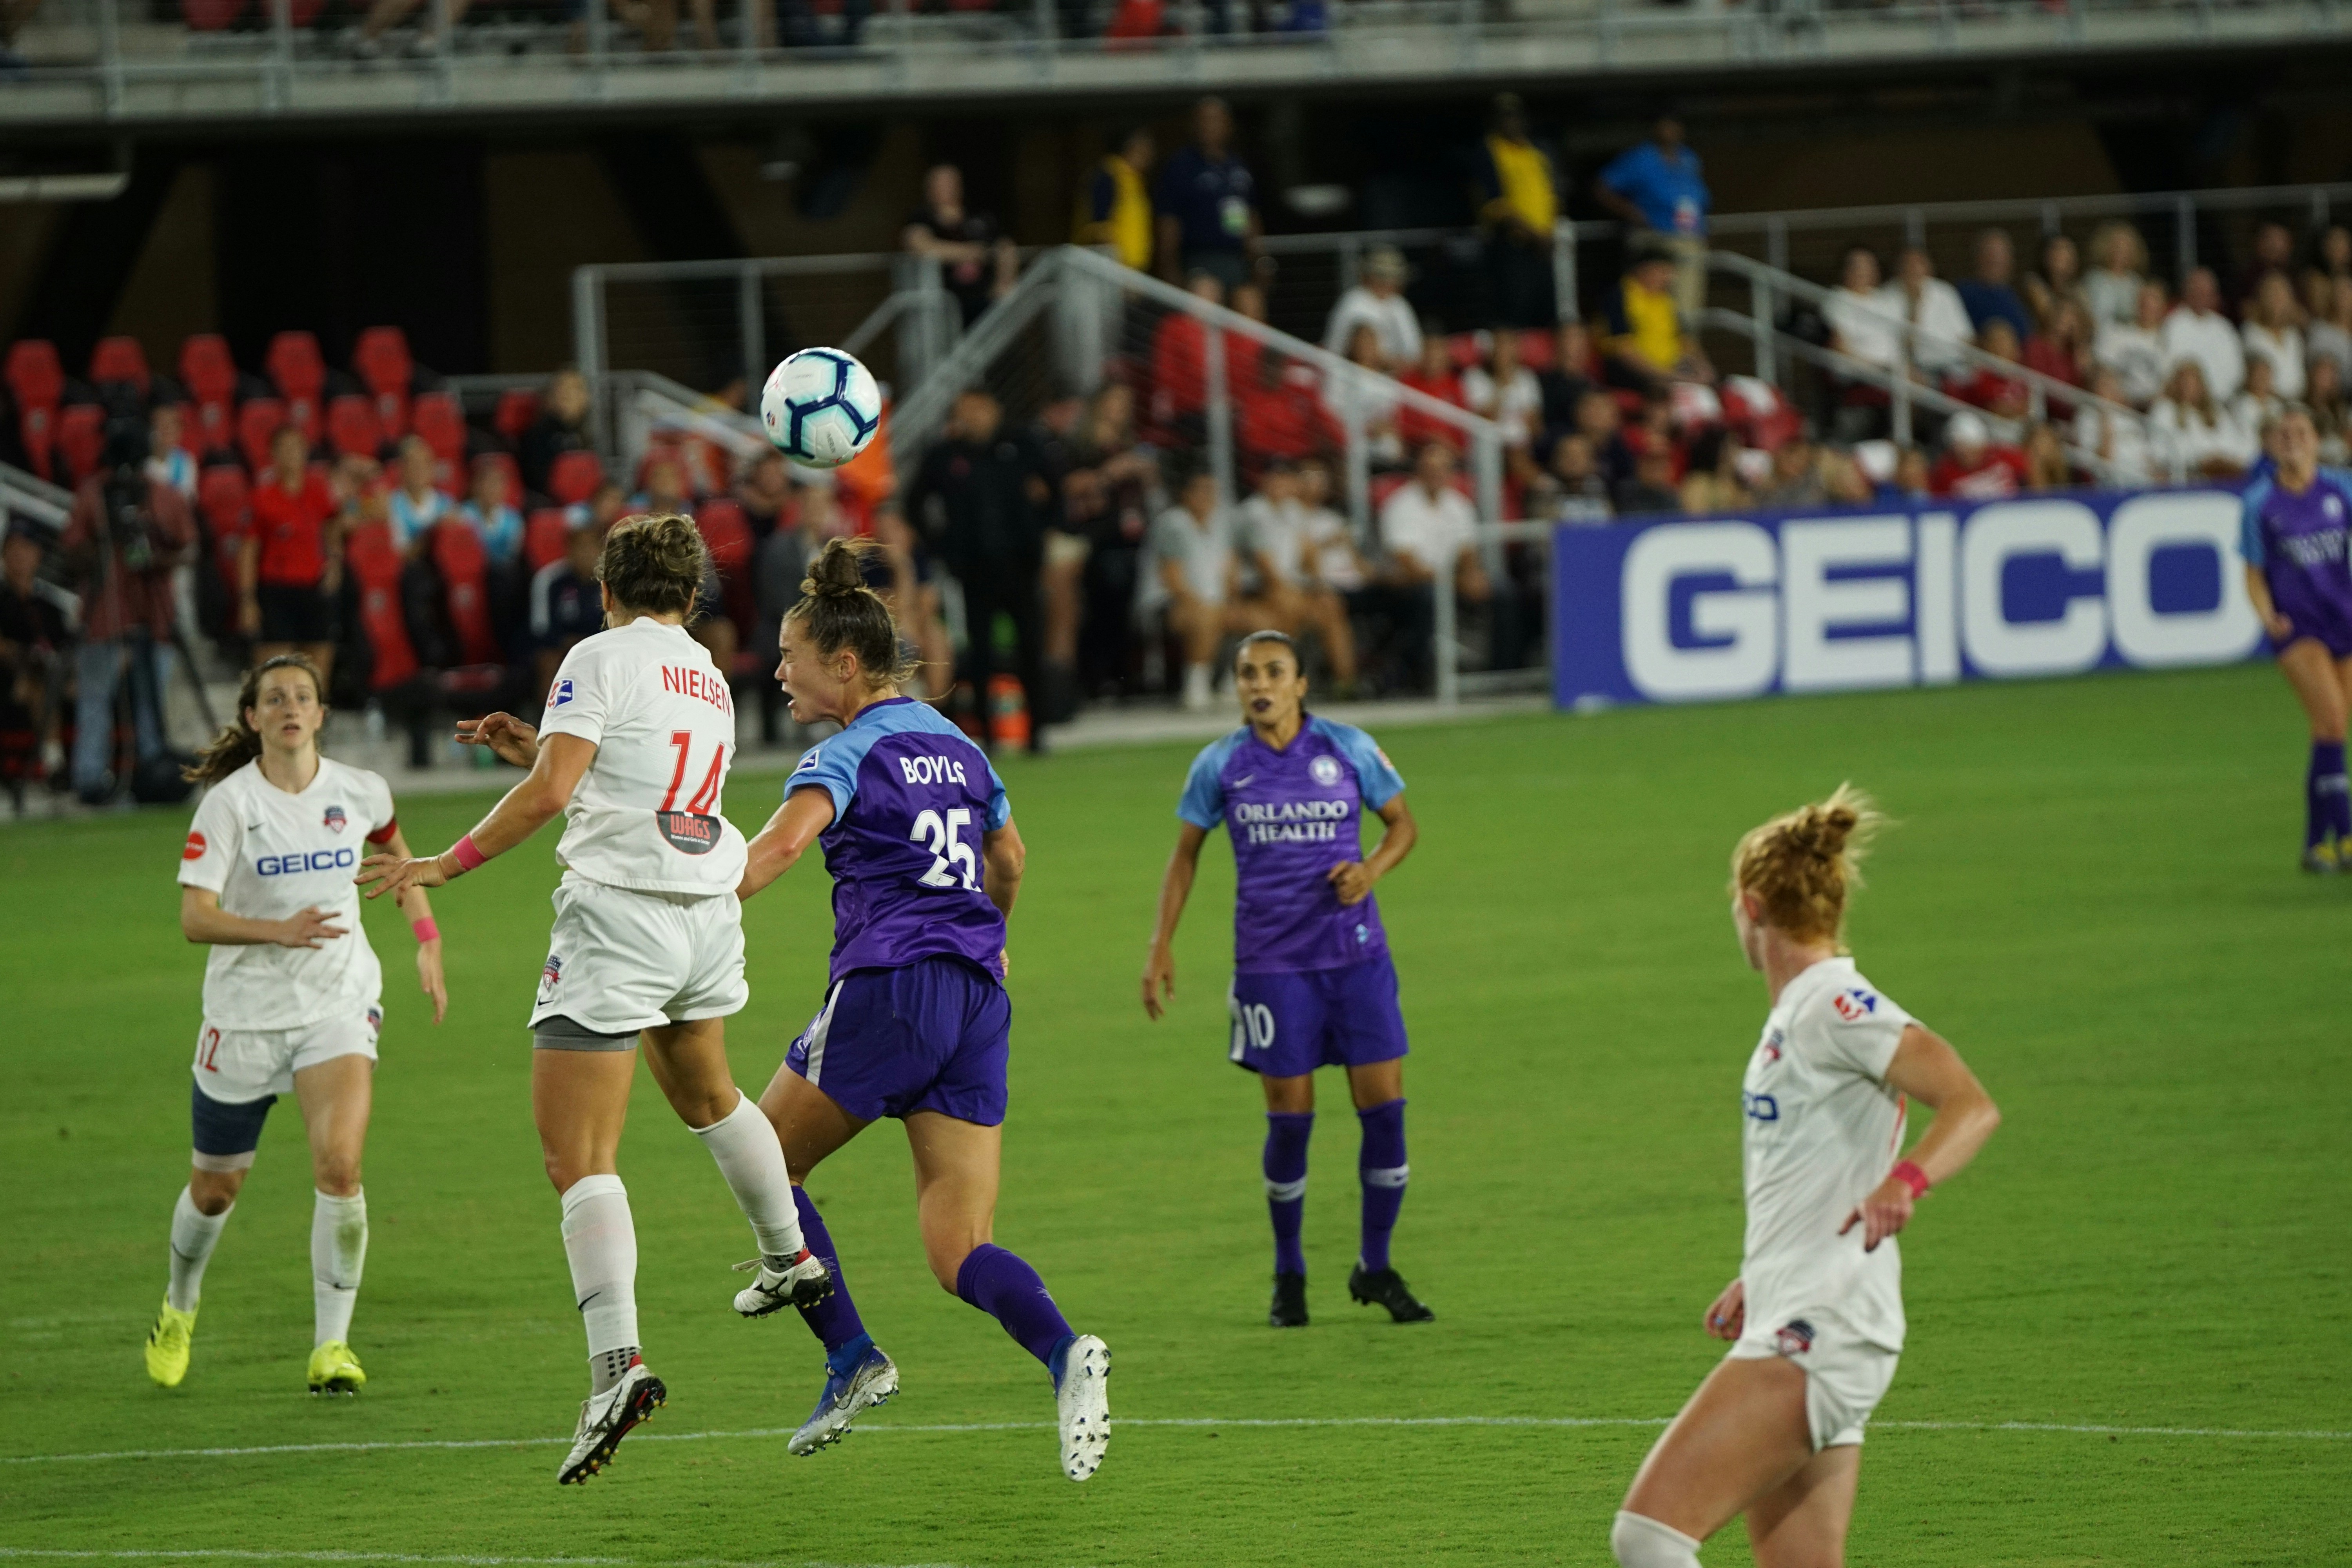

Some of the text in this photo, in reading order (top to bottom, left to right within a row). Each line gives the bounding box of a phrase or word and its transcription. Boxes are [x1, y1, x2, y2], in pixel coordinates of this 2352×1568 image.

[1621, 490, 2263, 704] GEICO
[661, 665, 730, 717] NIELSEN
[658, 730, 725, 817] 14
[670, 815, 710, 839] WAGS
[1235, 800, 1349, 824] ORLANDO
[1248, 822, 1336, 846] HEALTH
[257, 846, 354, 876] GEICO
[909, 808, 982, 893] 25
[199, 1024, 220, 1073] 12
[1243, 1003, 1275, 1049] 10
